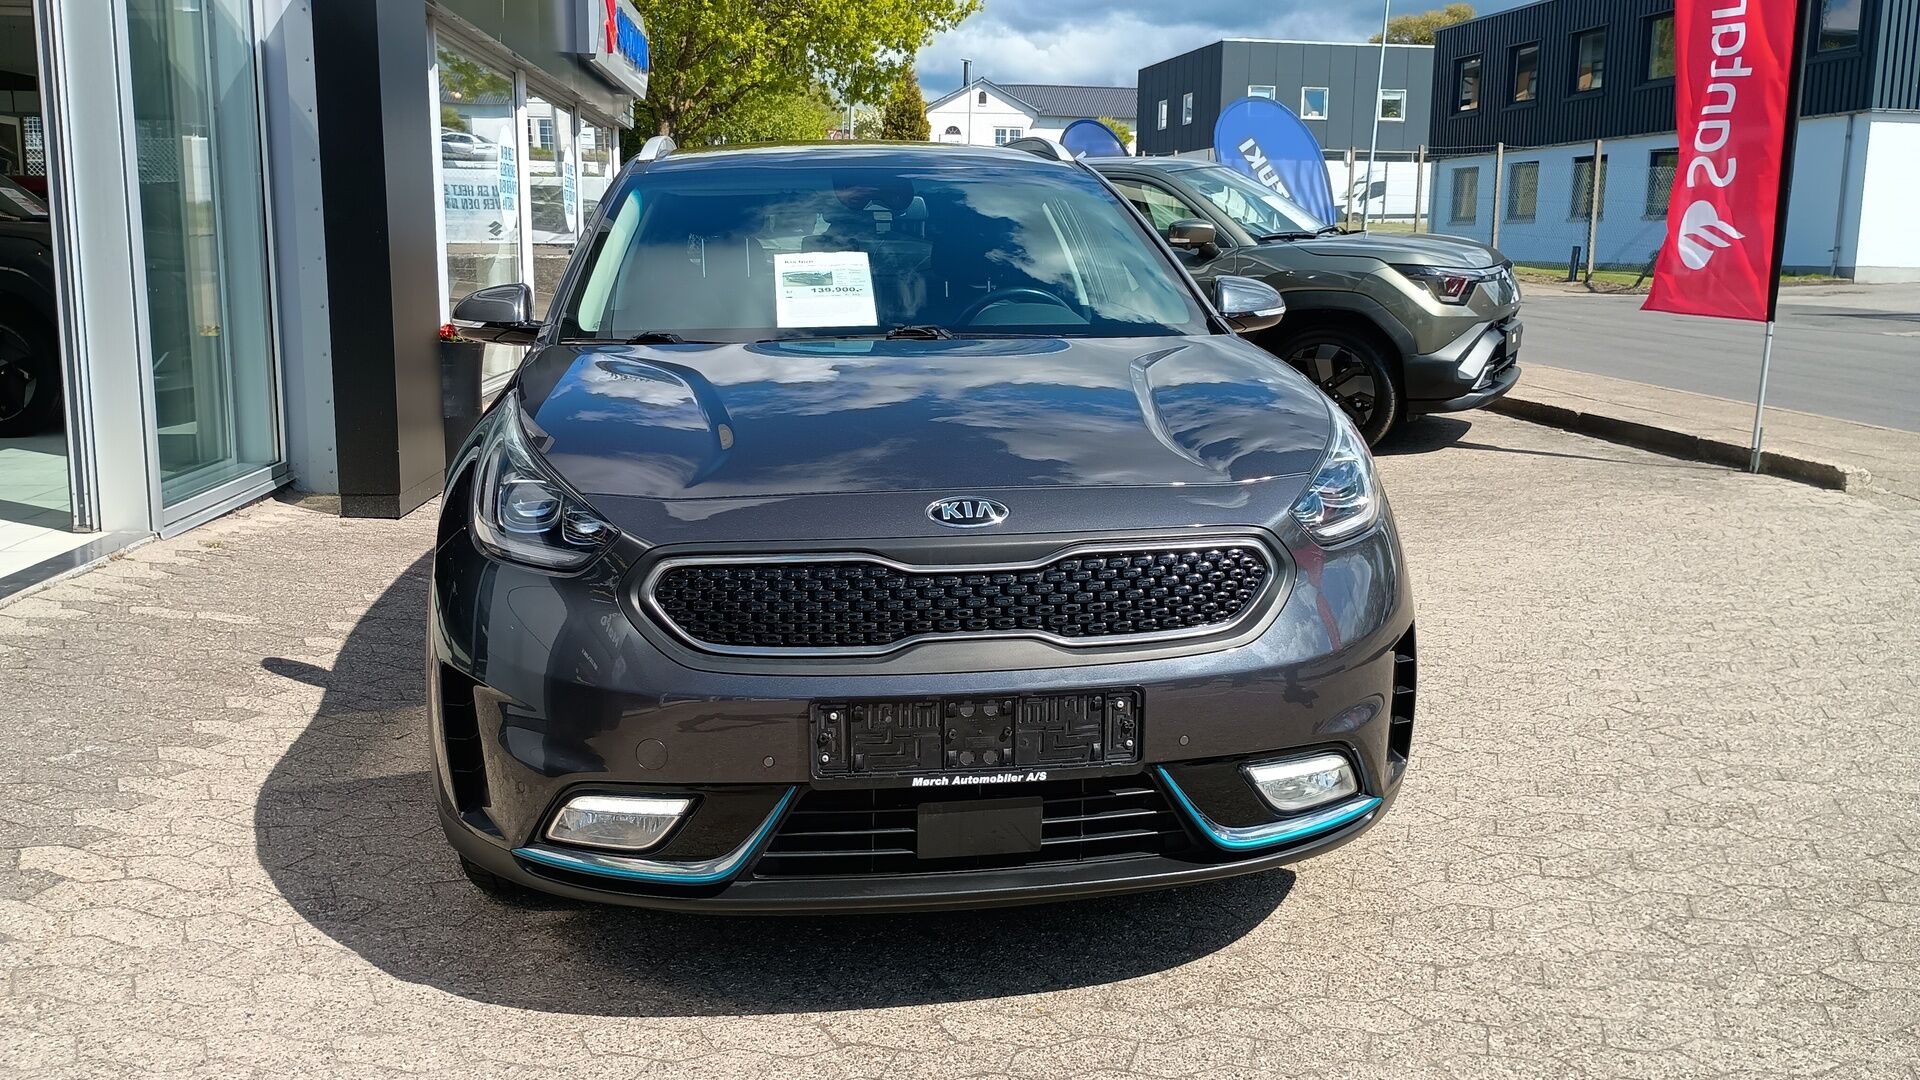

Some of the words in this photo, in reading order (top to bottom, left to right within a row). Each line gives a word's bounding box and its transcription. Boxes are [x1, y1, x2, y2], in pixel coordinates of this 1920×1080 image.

[940, 501, 998, 520] KIA
[952, 773, 1024, 786] Automobiler
[1026, 771, 1047, 782] A/S
